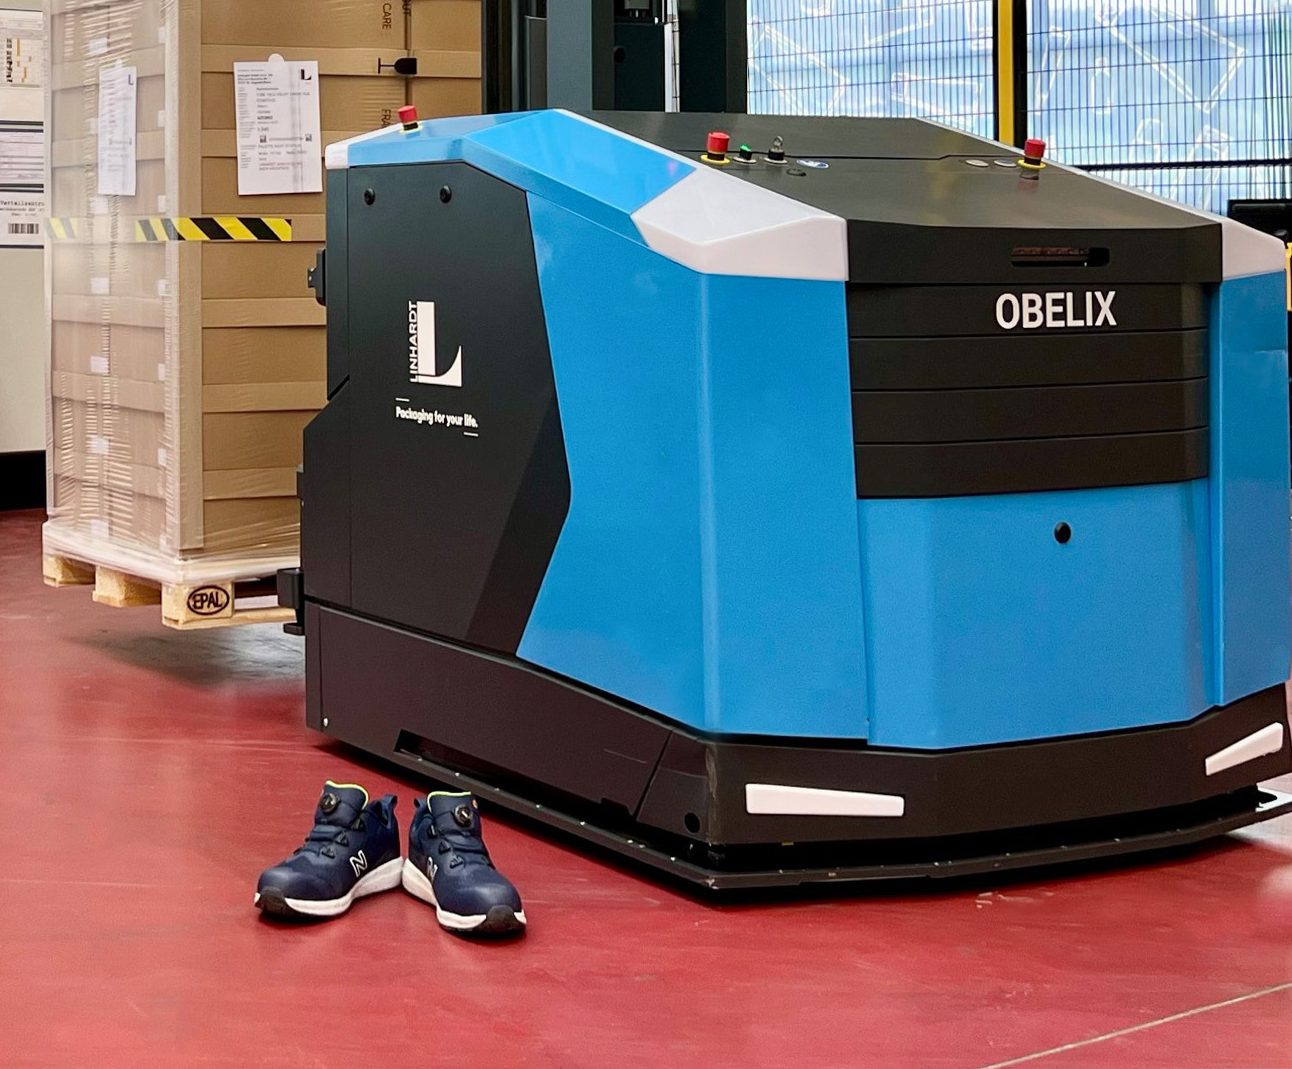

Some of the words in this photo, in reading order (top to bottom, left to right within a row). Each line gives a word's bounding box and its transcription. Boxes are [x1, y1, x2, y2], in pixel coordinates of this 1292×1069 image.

[382, 3, 392, 29] CARE
[995, 290, 1118, 330] OBELIX
[408, 300, 418, 383] LINHARDT
[395, 406, 434, 425] Packaging
[434, 410, 446, 423] for
[446, 414, 464, 427] your
[464, 412, 479, 428] life.
[192, 591, 223, 610] EPAL
